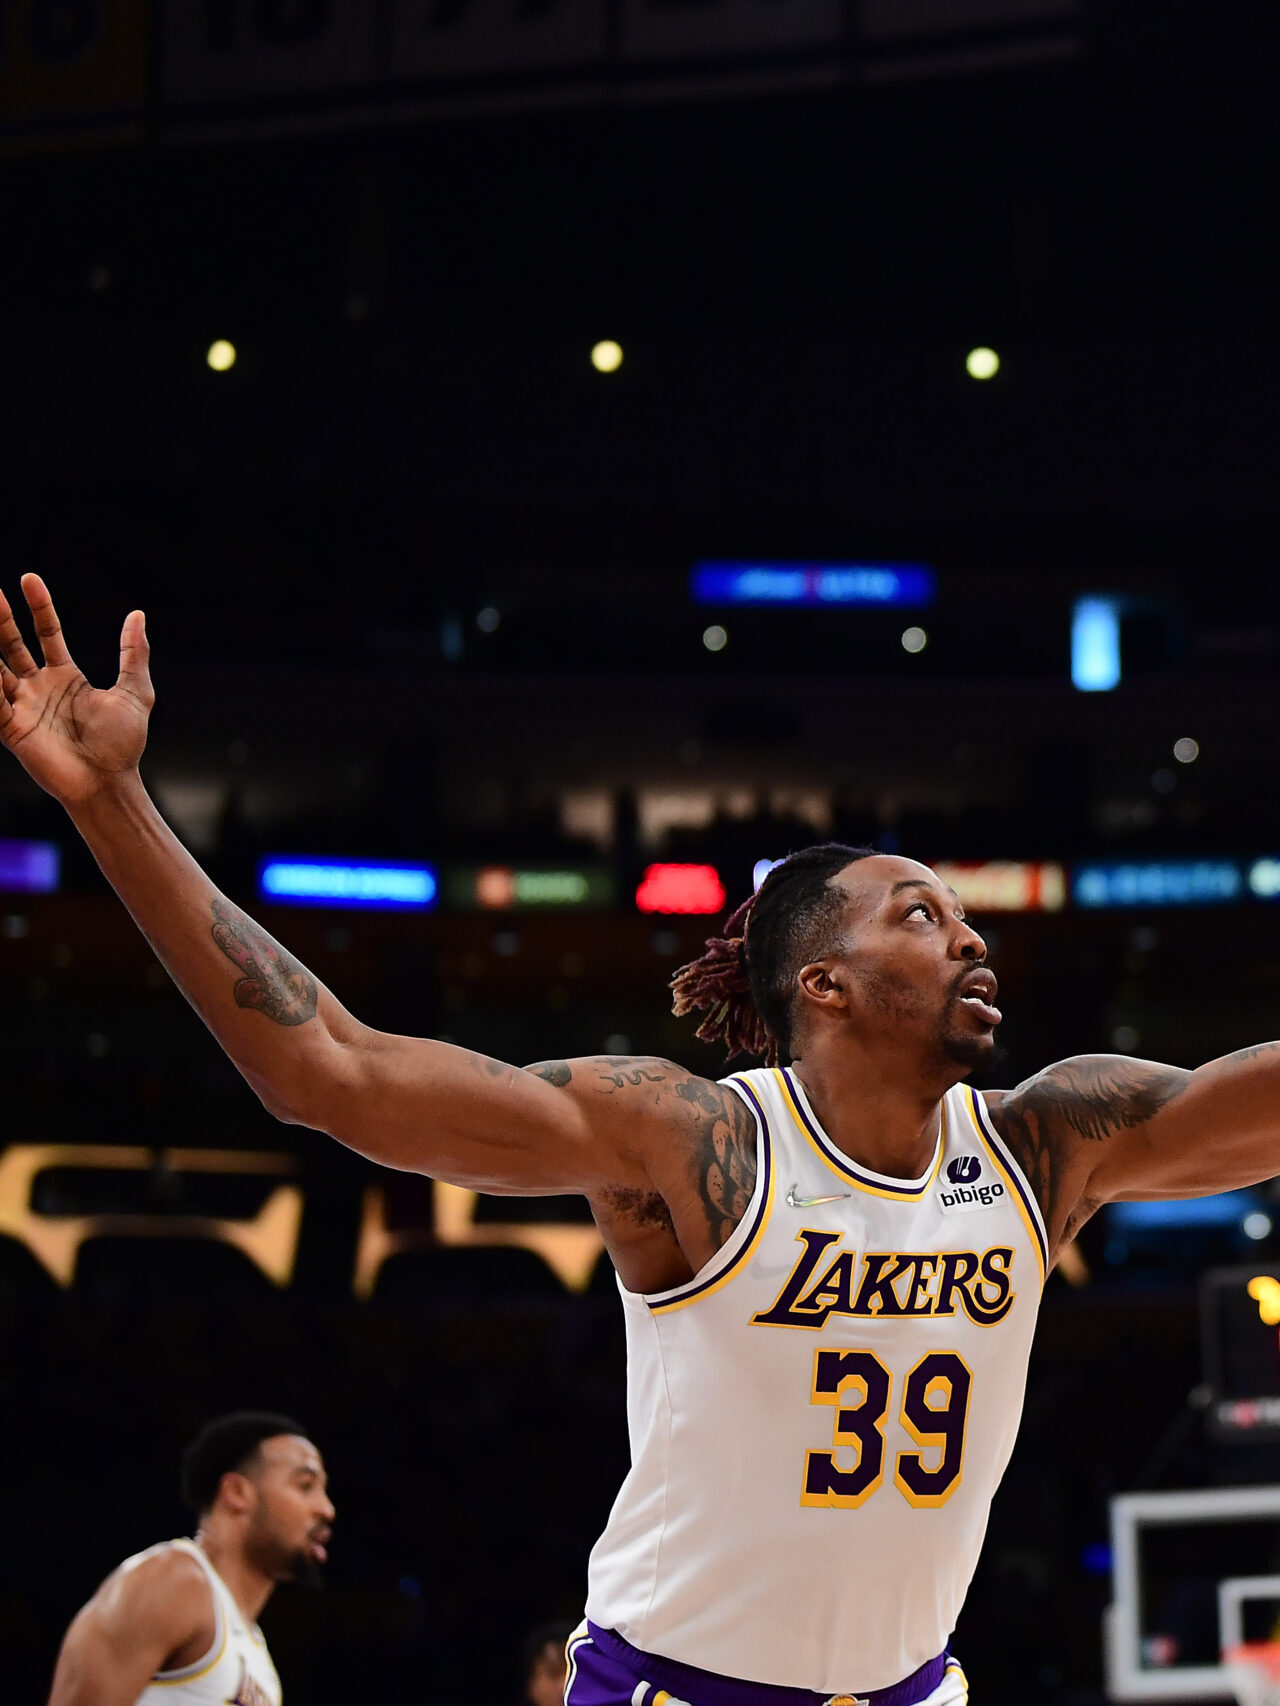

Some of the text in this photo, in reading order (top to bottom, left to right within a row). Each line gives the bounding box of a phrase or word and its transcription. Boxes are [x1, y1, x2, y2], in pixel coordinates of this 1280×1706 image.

[940, 1182, 1004, 1208] bibigo
[748, 1228, 1016, 1331] LAKERS
[800, 1347, 974, 1509] 39
